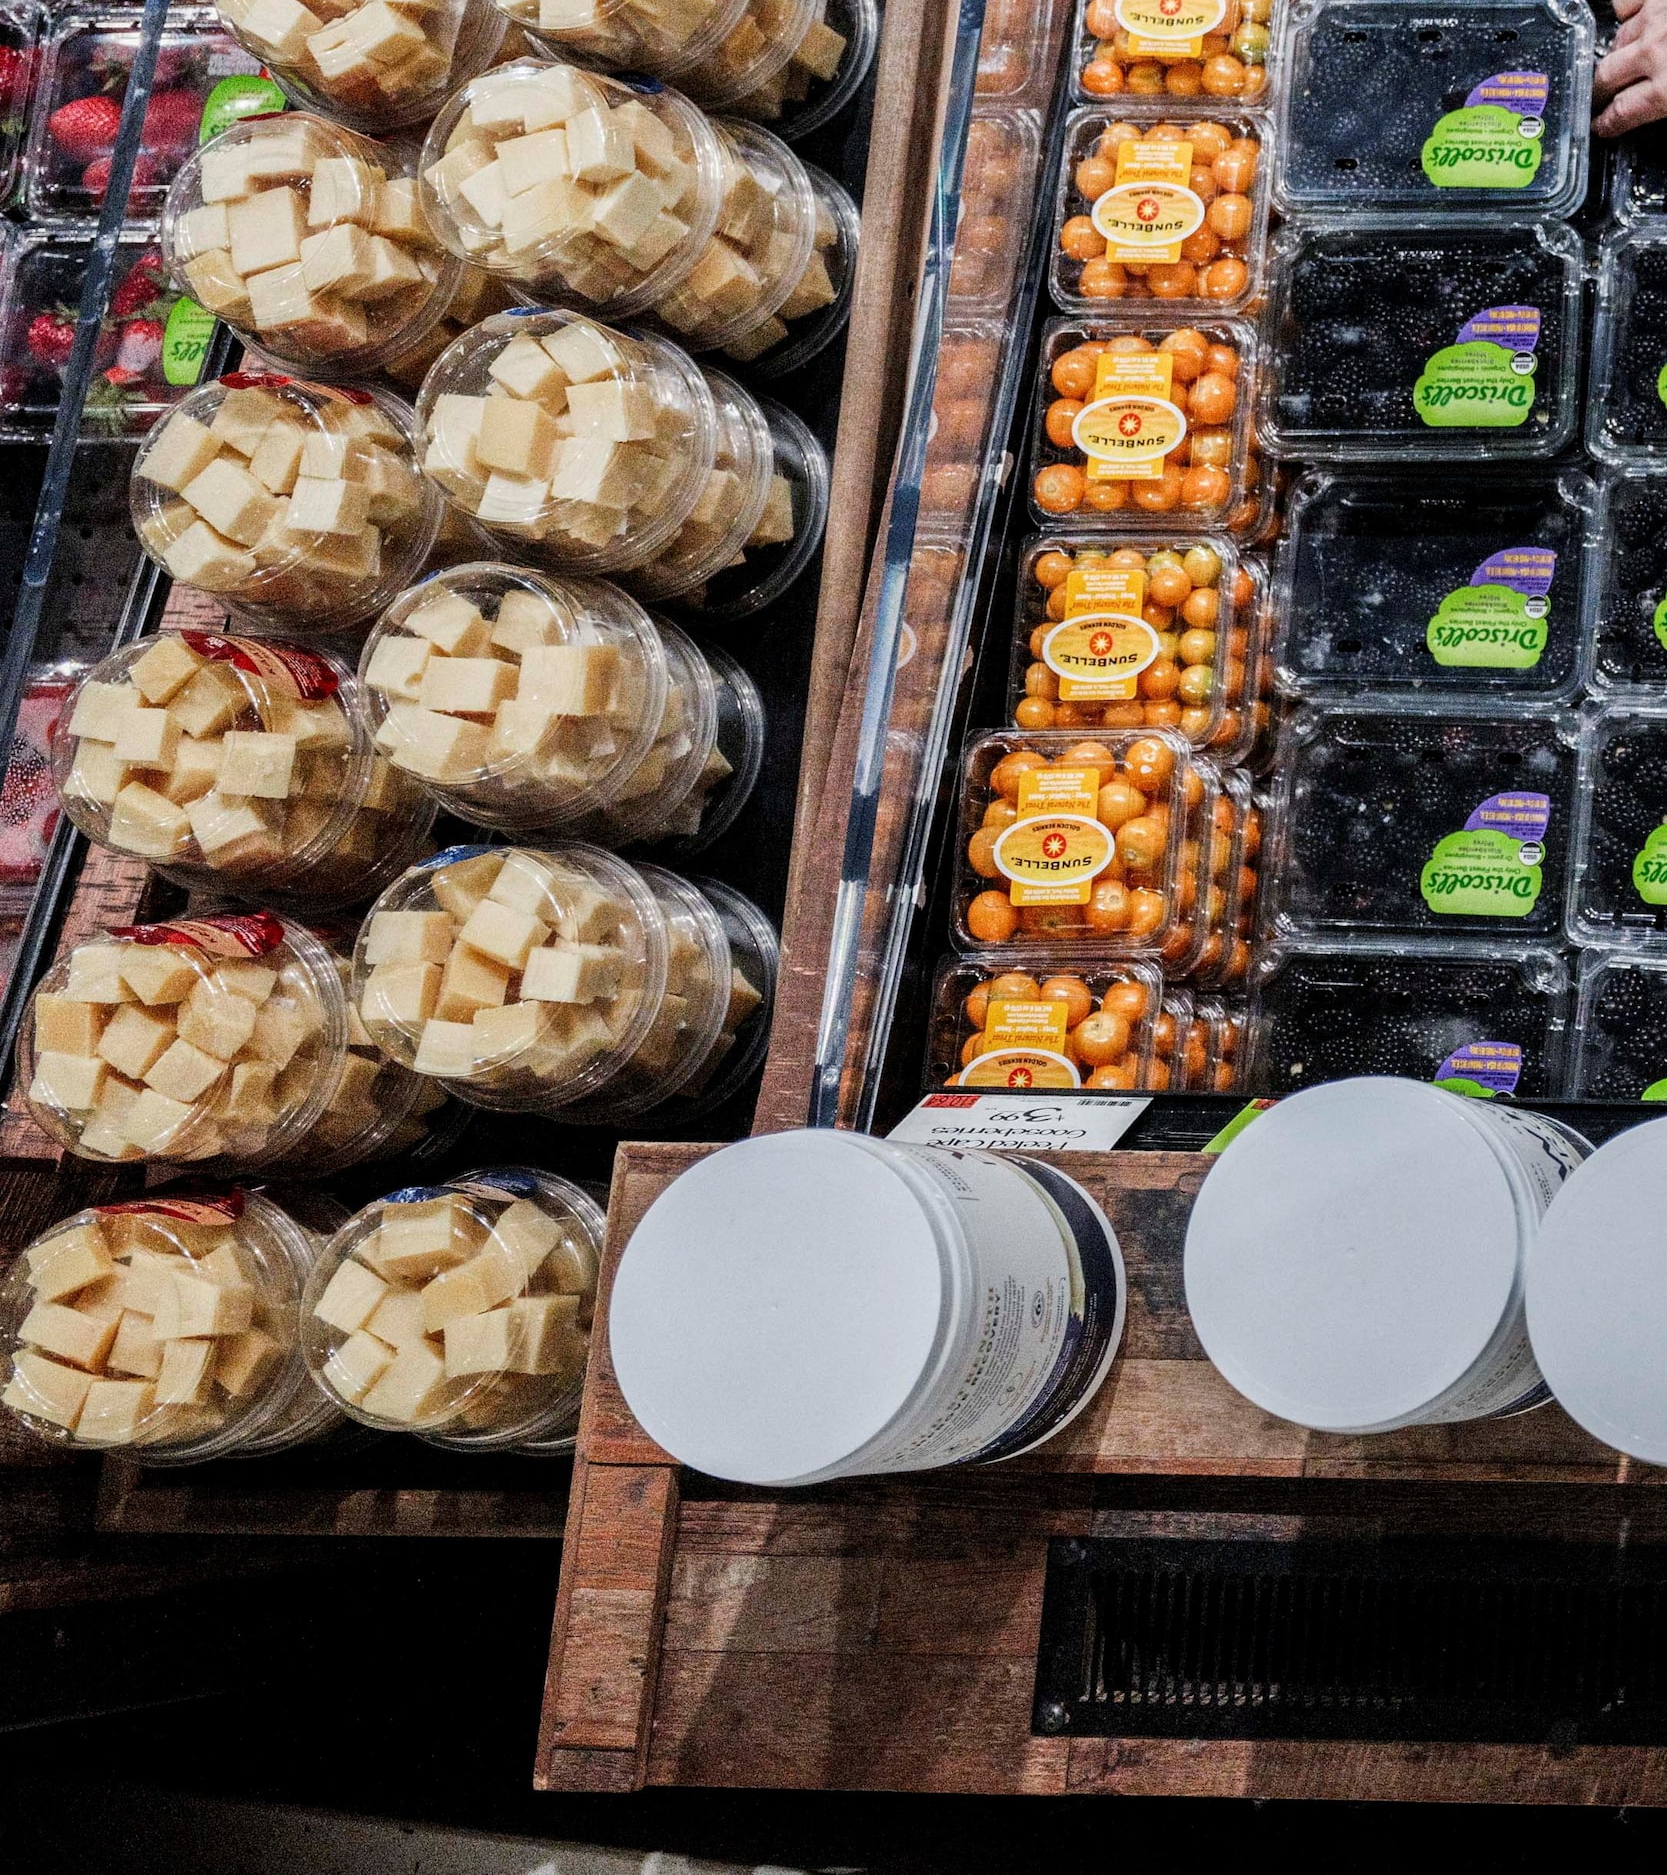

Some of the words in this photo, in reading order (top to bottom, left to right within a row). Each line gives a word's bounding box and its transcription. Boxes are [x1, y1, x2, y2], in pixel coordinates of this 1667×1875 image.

[1429, 144, 1535, 169] Driscoll's
[1417, 379, 1528, 405] Driscoll's
[1436, 625, 1537, 649] Driscoll's
[1427, 872, 1532, 895] Driscoll's
[926, 1138, 985, 1149] Cape
[931, 1126, 1087, 1138] Gooseberries
[986, 1138, 1068, 1150] Peeled
